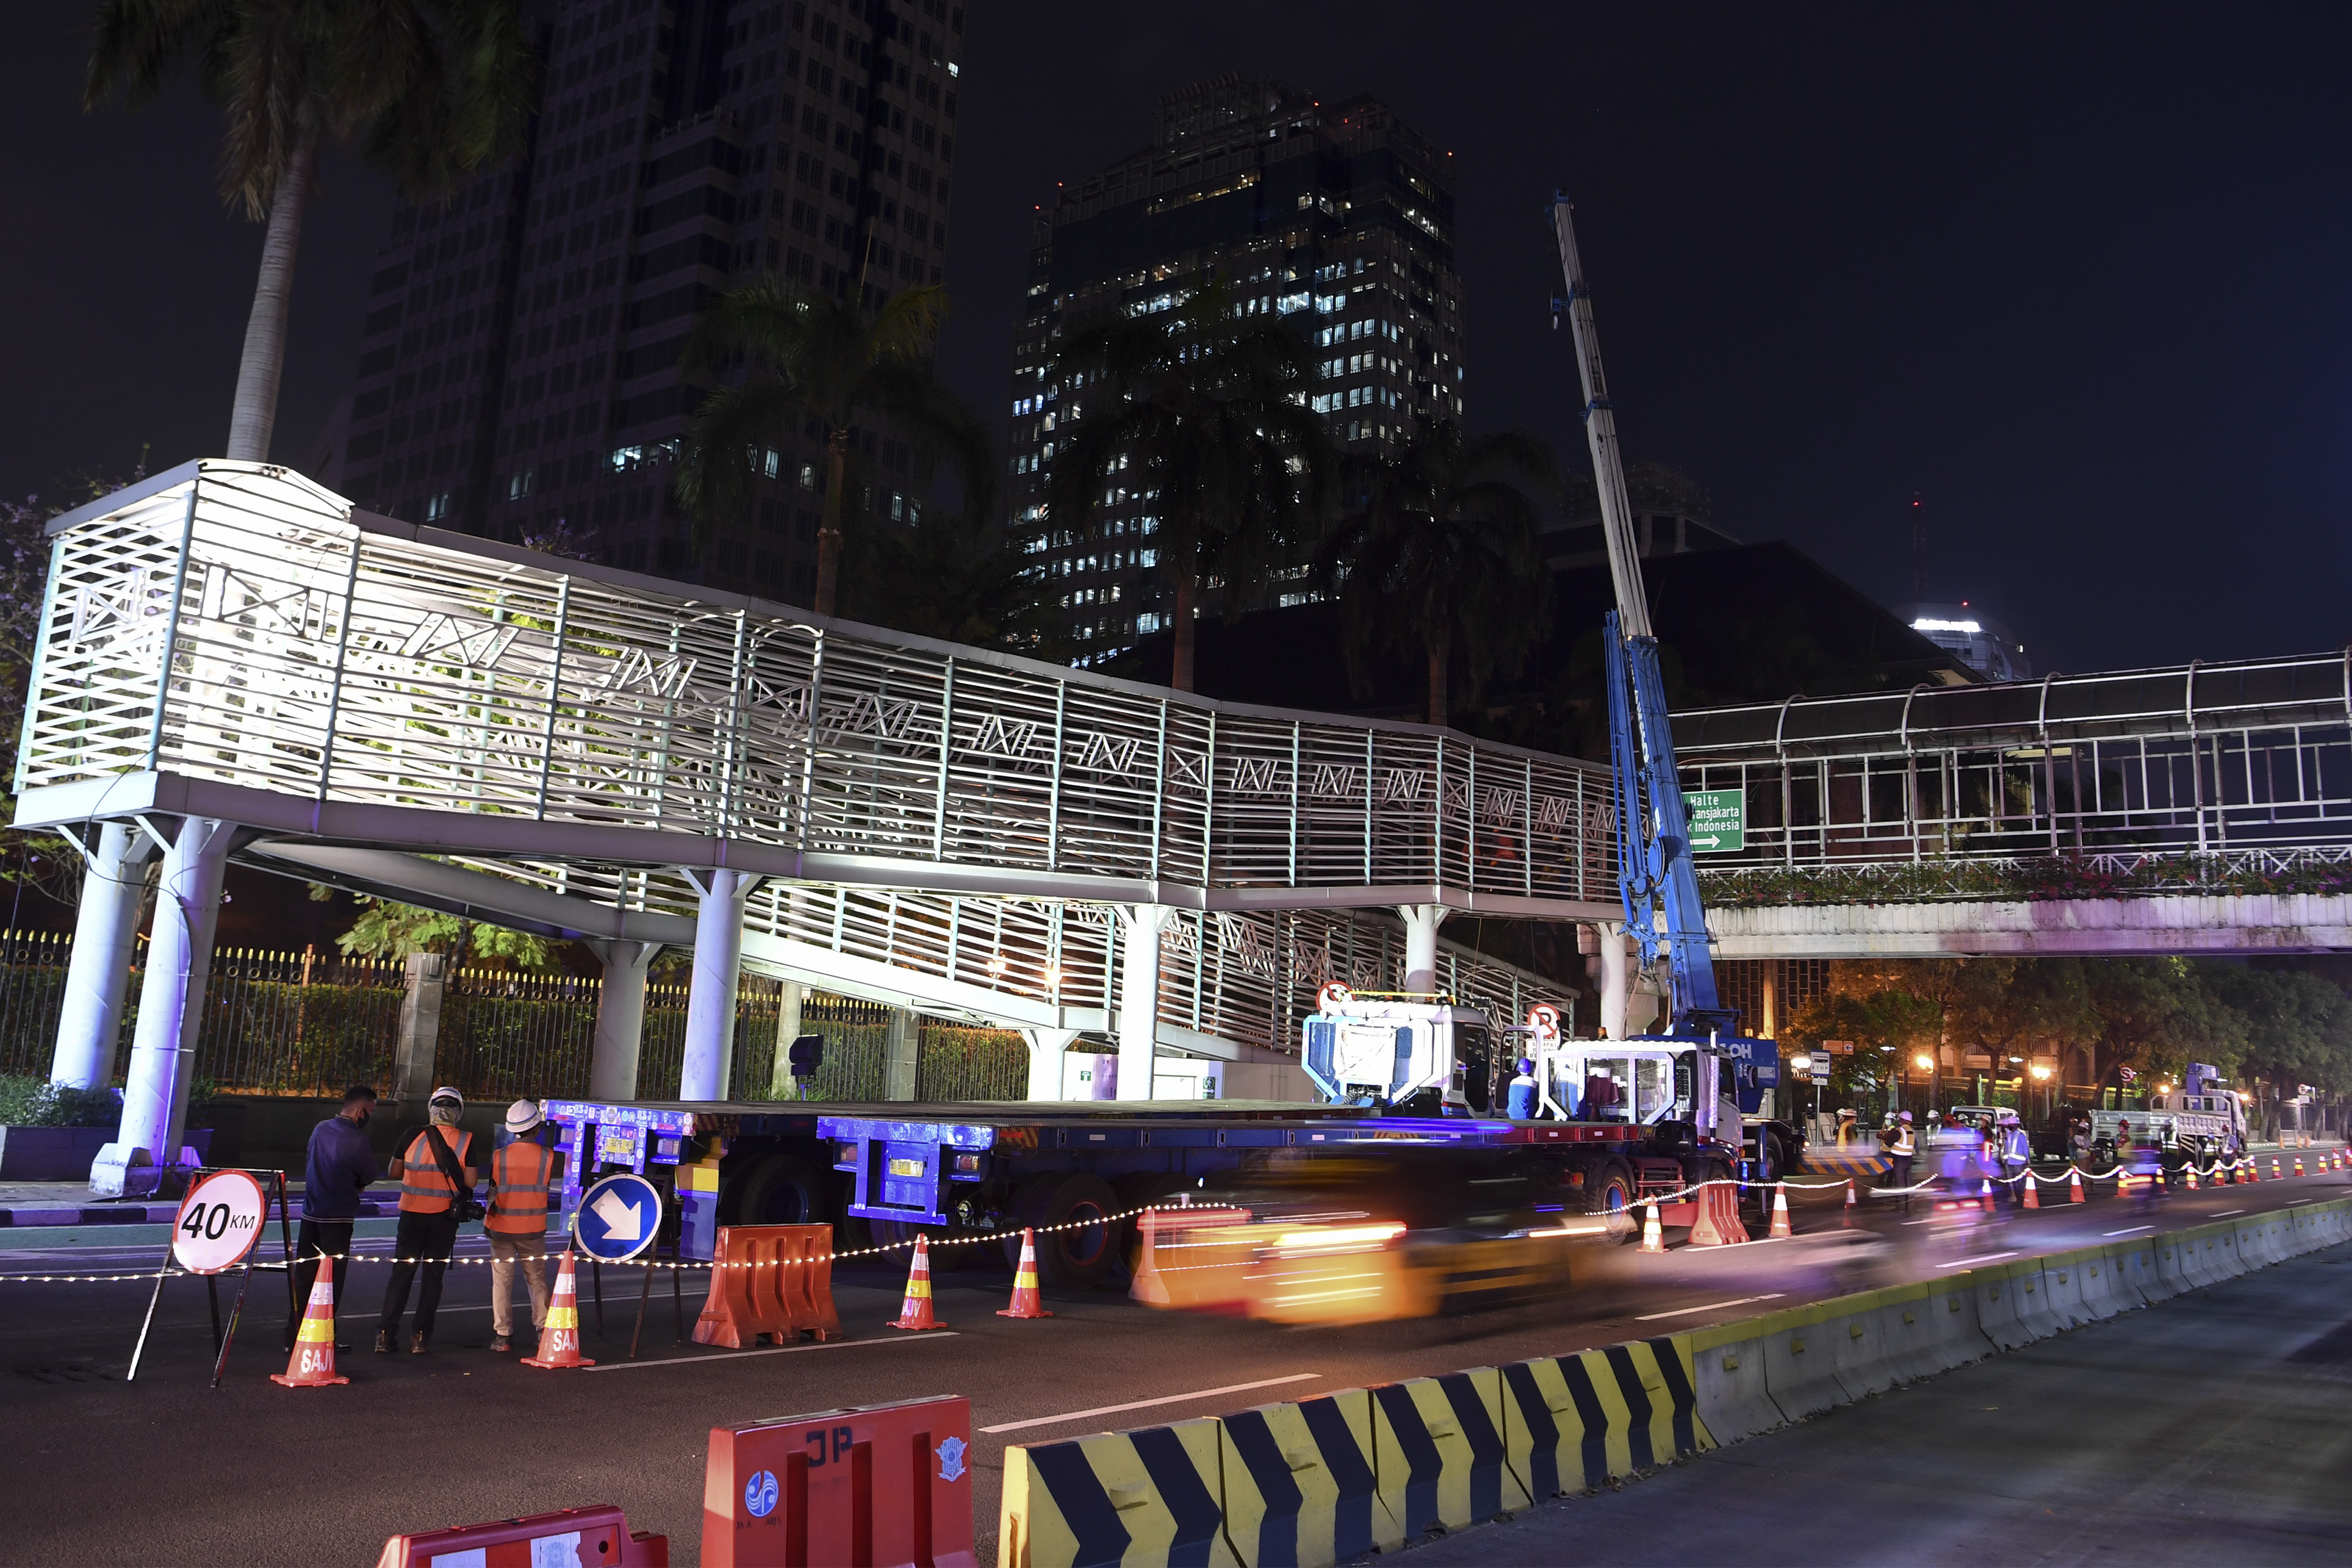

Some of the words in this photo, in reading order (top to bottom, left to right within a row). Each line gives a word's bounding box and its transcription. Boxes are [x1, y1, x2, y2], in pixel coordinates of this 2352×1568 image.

[1690, 794, 1719, 807] Halte
[1692, 806, 1740, 821] ransjakarta
[1695, 818, 1740, 833] Indonesia
[181, 1202, 230, 1241] 40
[230, 1215, 256, 1229] KM
[806, 1426, 853, 1467] JP
